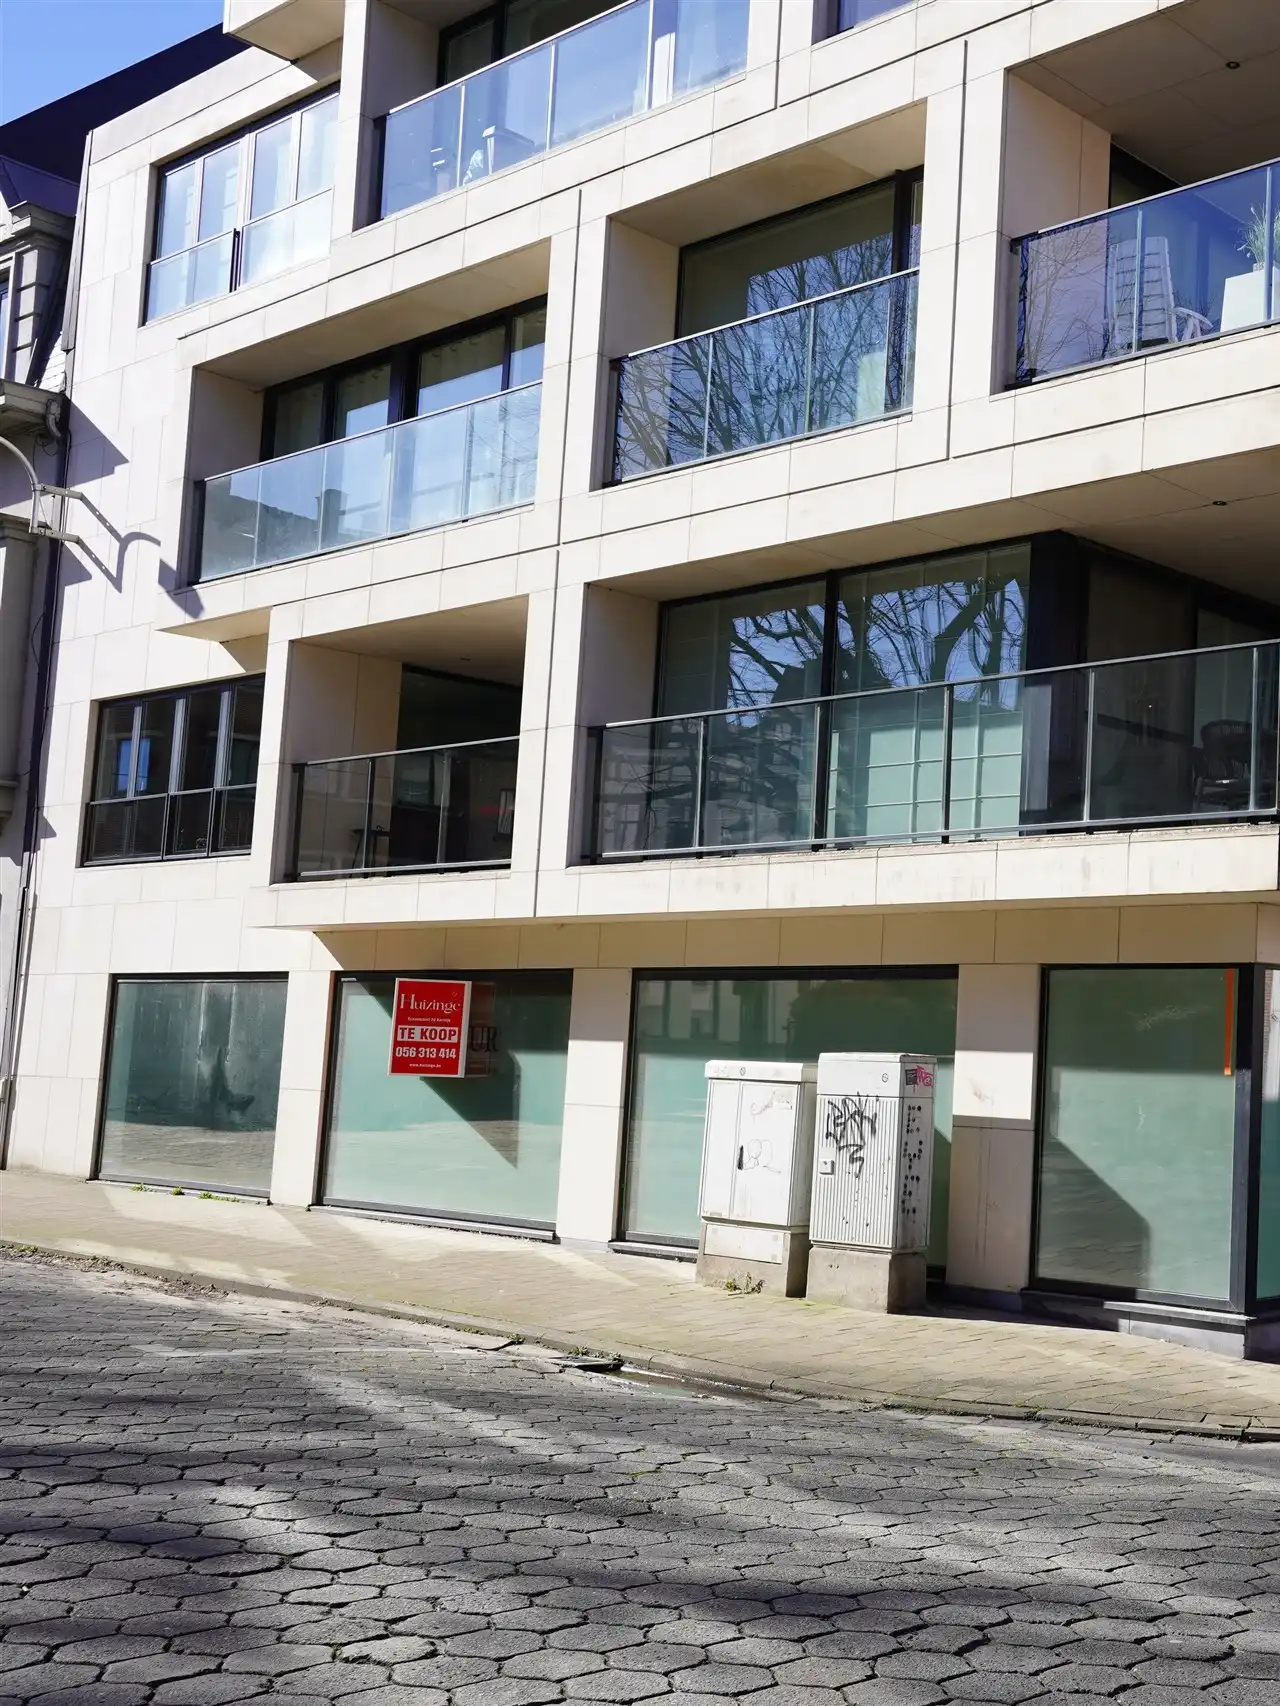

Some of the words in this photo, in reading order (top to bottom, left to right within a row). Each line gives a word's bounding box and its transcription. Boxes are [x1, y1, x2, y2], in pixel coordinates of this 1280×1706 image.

[400, 993, 461, 1013] Huizinge
[399, 1027, 415, 1039] TE
[420, 1028, 457, 1041] KOOP
[395, 1047, 416, 1057] 056
[418, 1047, 436, 1058] 313
[438, 1048, 456, 1058] 414
